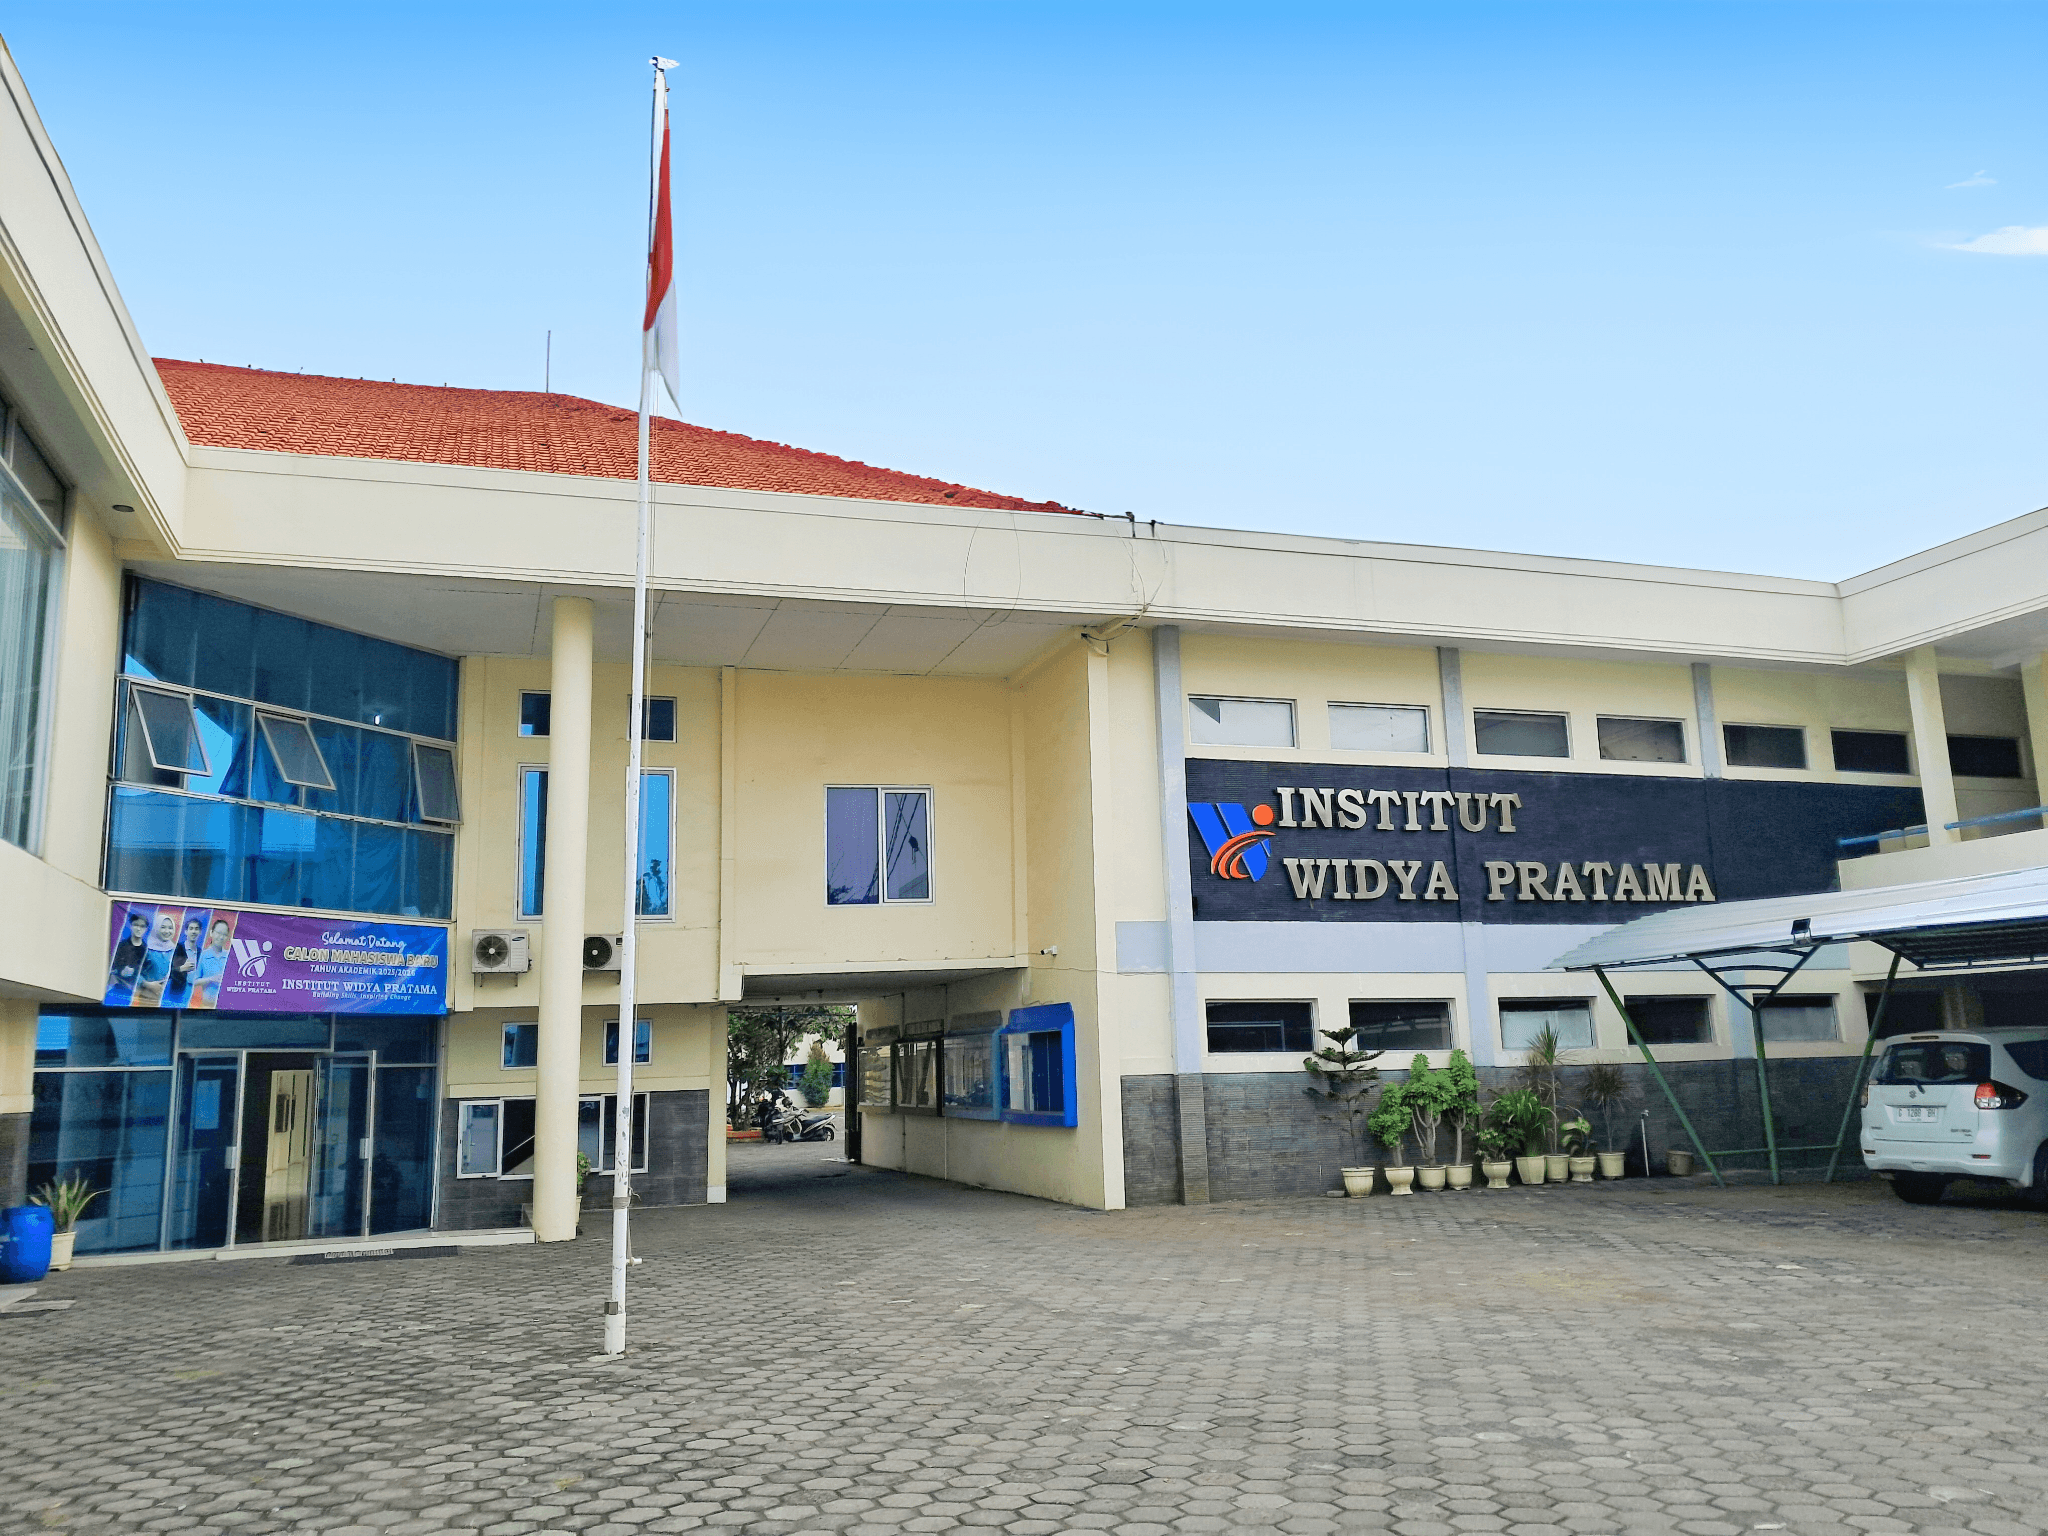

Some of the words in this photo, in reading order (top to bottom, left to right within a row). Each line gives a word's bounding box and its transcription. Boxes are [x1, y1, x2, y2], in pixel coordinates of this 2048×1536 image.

[1275, 786, 1522, 833] INSTITUT
[1282, 858, 1459, 901] WIDYA
[1484, 861, 1716, 902] PRATAMA
[321, 931, 367, 947] Selamat
[367, 934, 407, 954] Datang
[283, 945, 330, 963] CALON
[331, 948, 406, 967] MAHASISWA
[406, 953, 438, 968] BARU
[310, 964, 337, 973] TAHUN
[338, 965, 378, 975] AKADEMIK
[378, 967, 416, 977] 2025/2026
[282, 978, 340, 992] INSTITUT
[342, 981, 381, 993] WIDYA
[384, 983, 438, 995] PRATAMA
[312, 991, 340, 1000] Building
